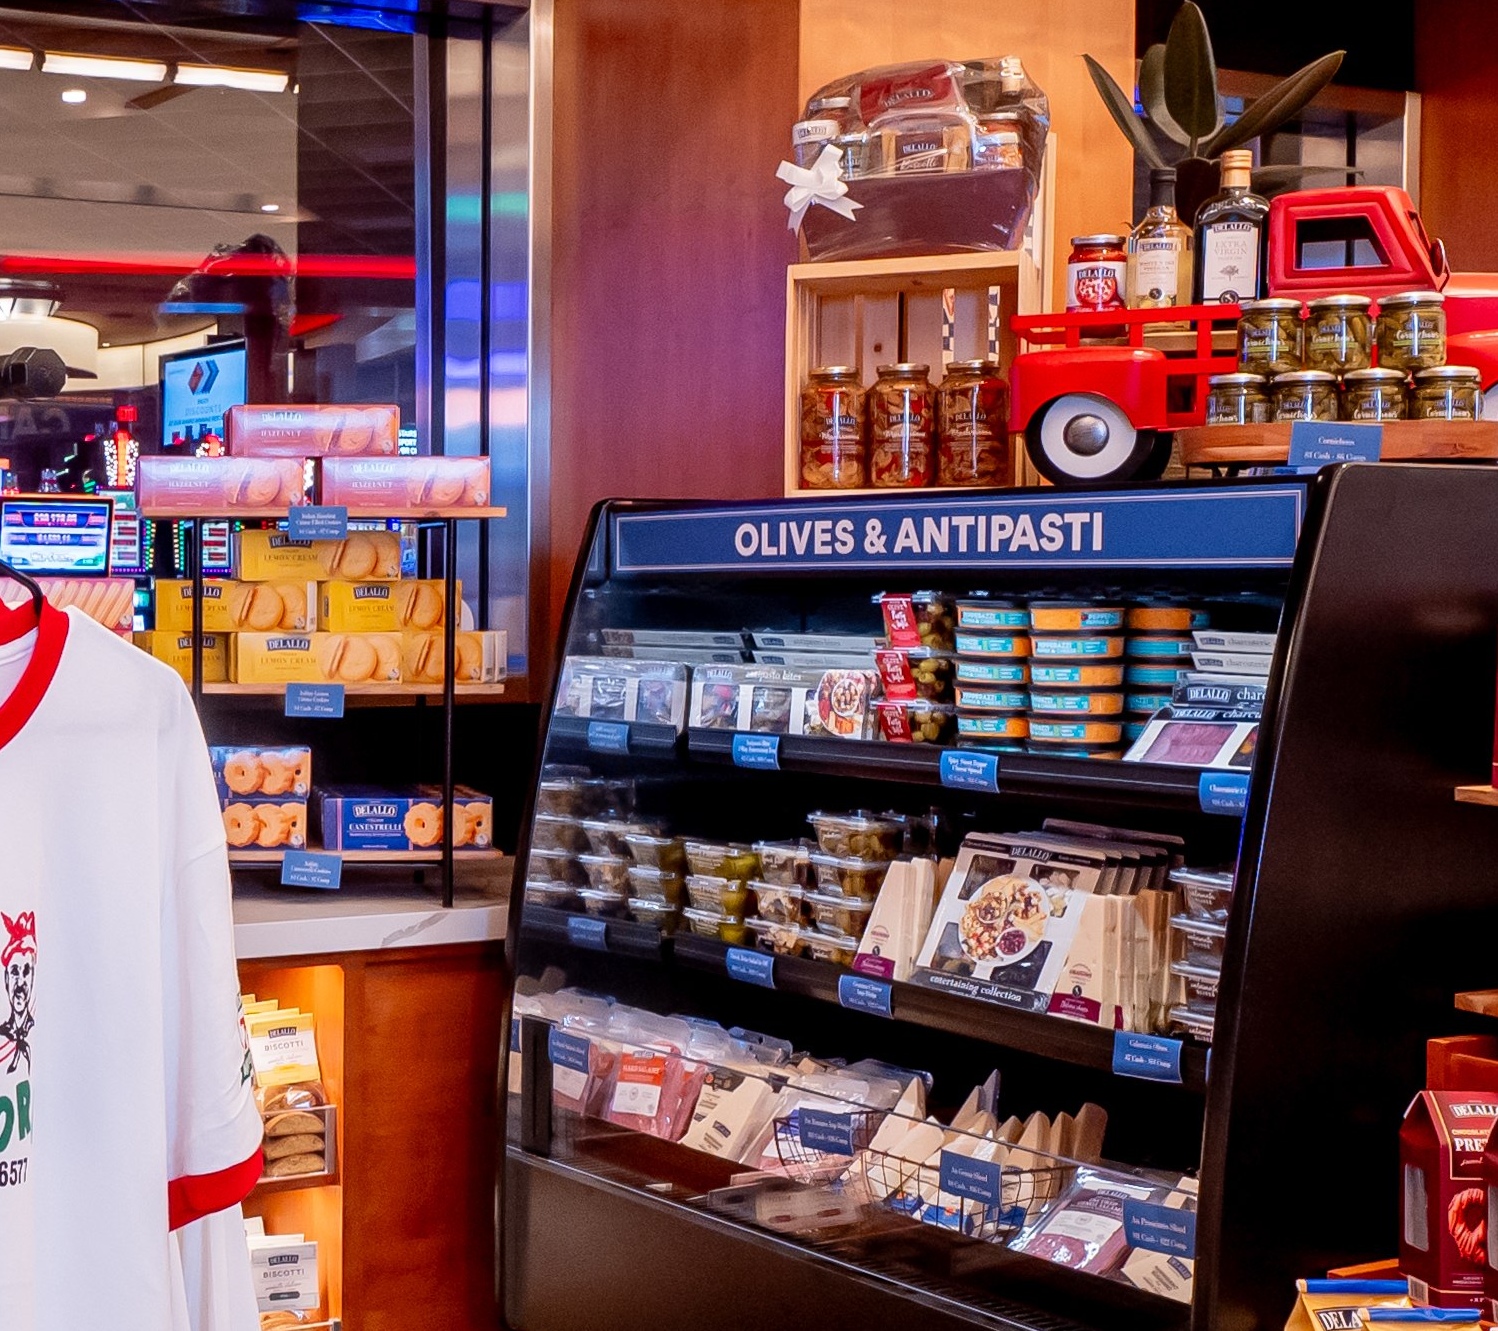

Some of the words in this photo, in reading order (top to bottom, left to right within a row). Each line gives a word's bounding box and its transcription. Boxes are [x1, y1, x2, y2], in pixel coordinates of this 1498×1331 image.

[1213, 223, 1253, 233] DELALLO
[1214, 247, 1247, 255] VIRGIN
[1318, 437, 1356, 446] Cornichons
[735, 518, 854, 558] OLIVES
[864, 519, 887, 554] &
[894, 512, 1104, 554] ANTIPASTI
[267, 638, 311, 651] DELALLO
[782, 670, 802, 681] bites
[1011, 847, 1051, 861] DELALLO
[929, 975, 978, 995] entertaining
[980, 986, 1022, 1002] collection
[264, 1040, 304, 1052] BISCOTTI
